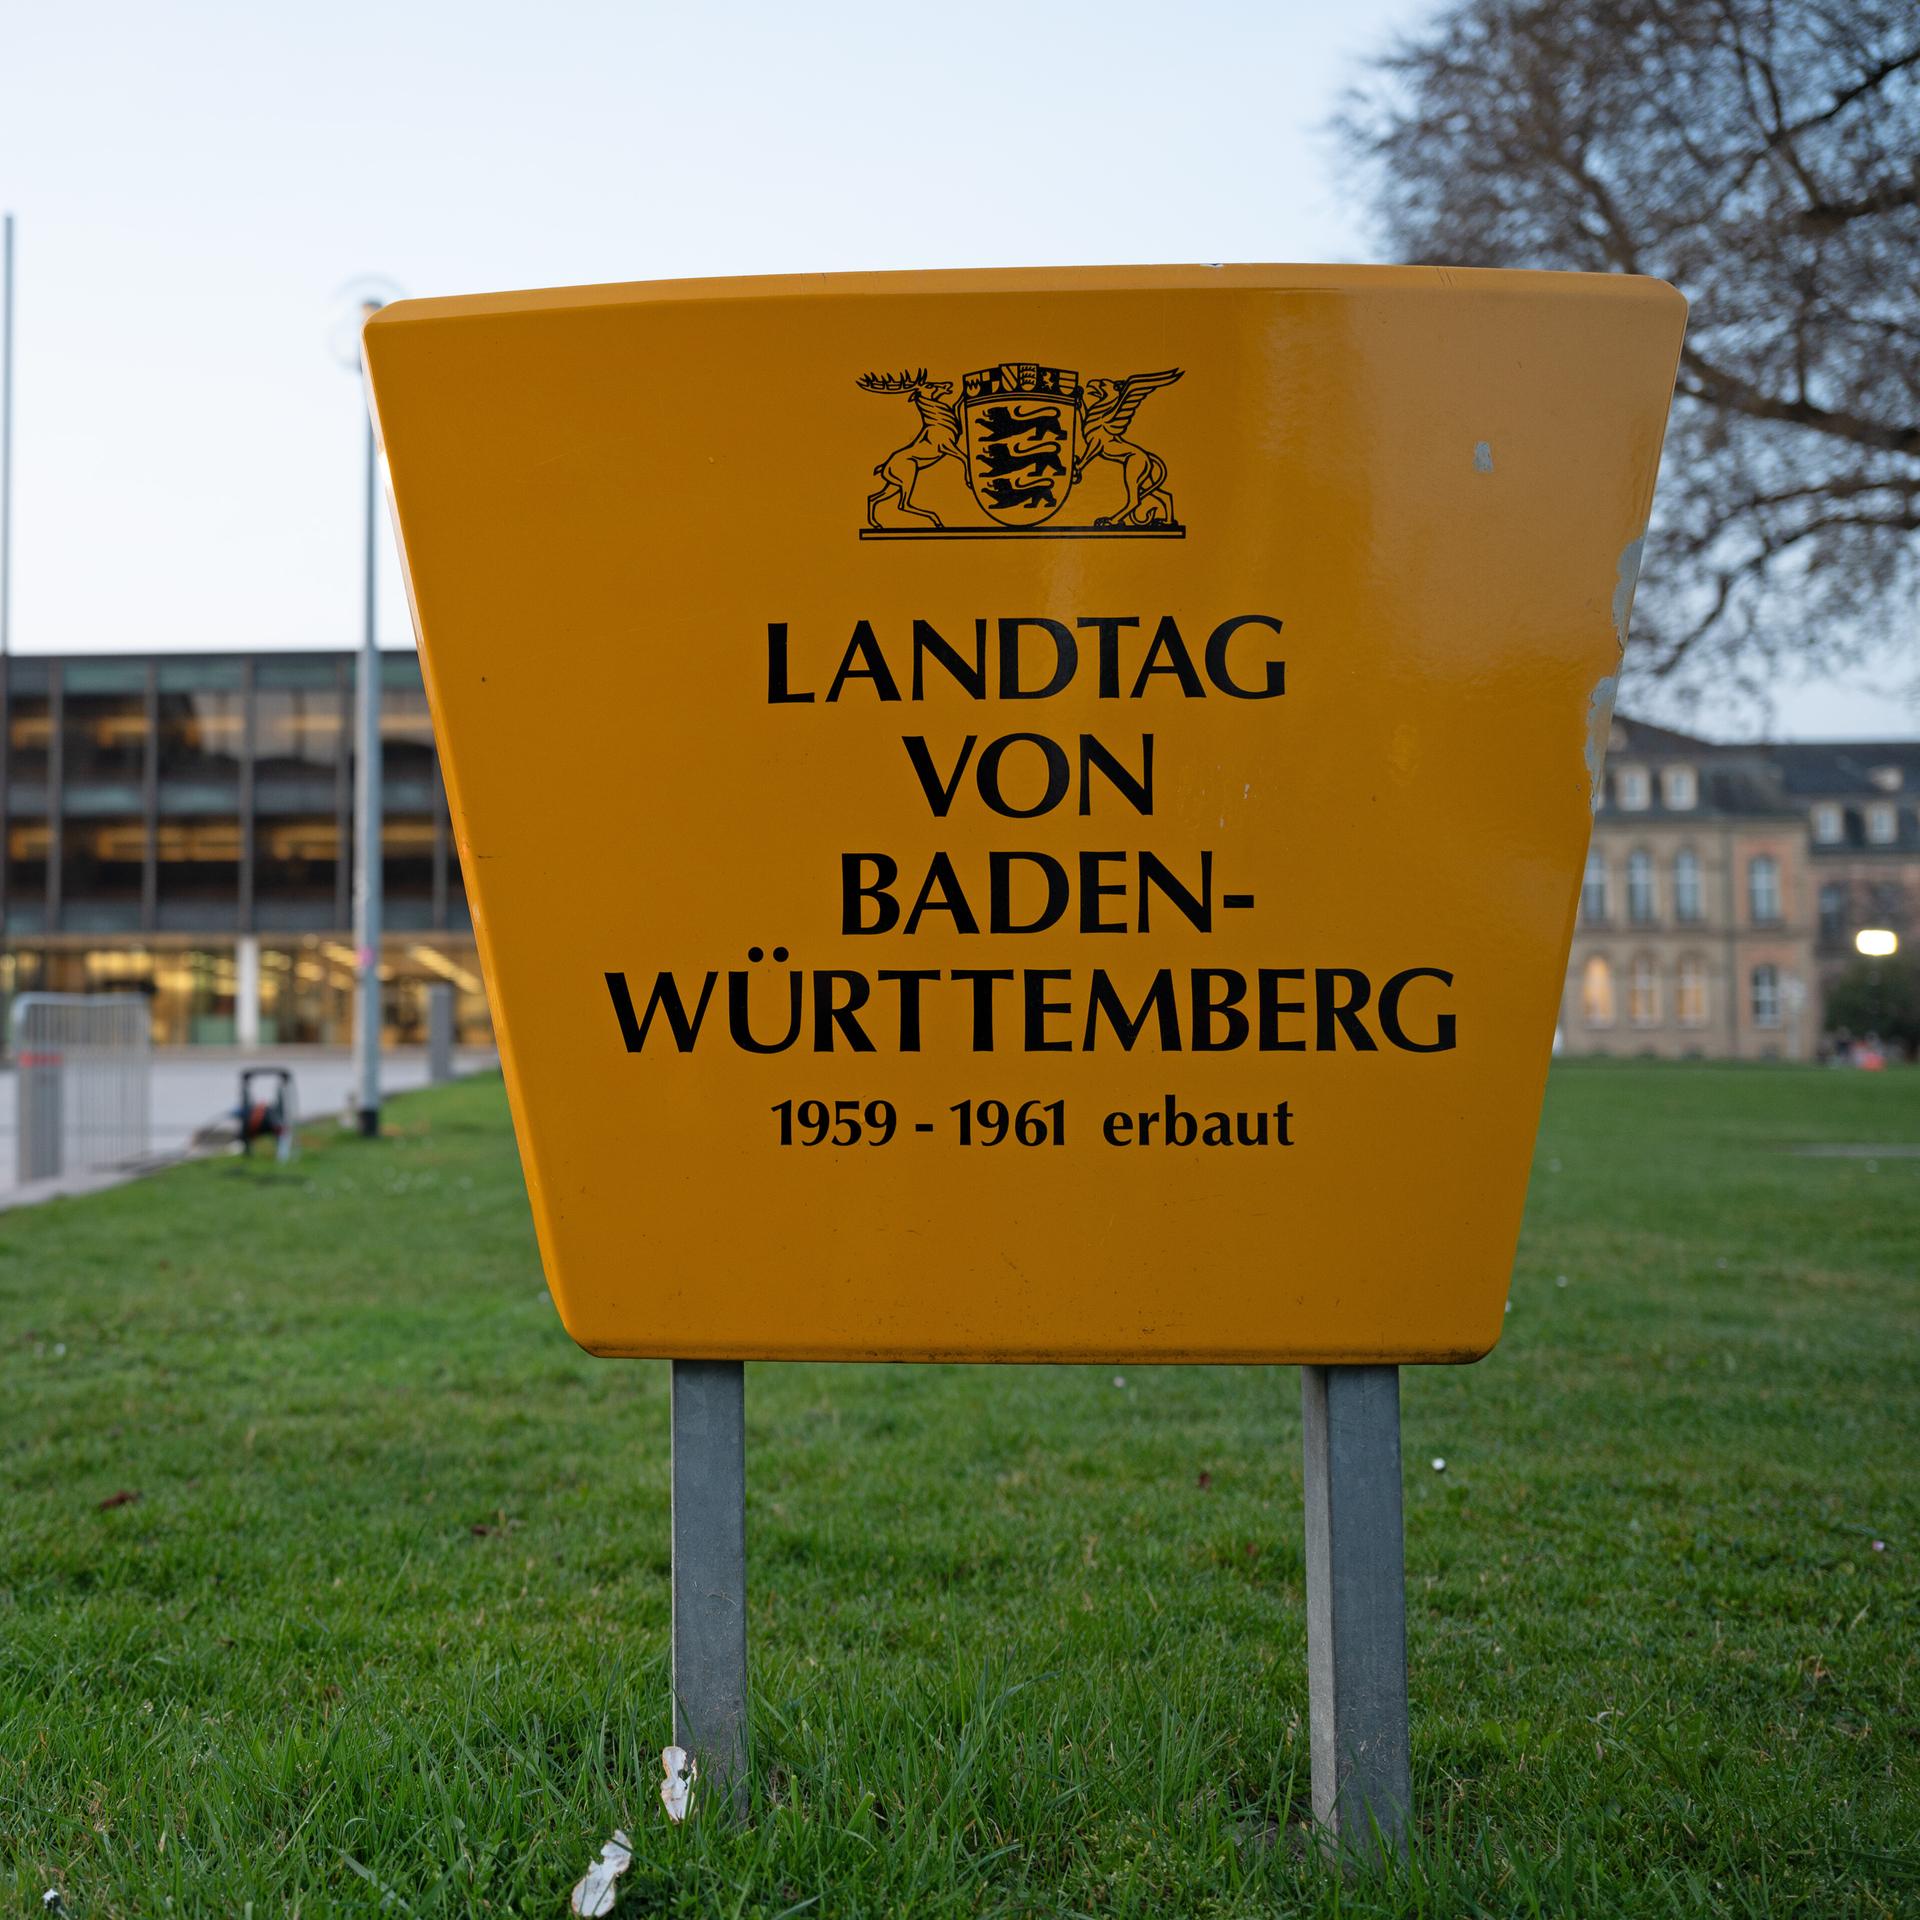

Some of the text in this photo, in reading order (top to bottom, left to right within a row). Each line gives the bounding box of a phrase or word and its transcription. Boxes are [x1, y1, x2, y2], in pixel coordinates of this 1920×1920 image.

[767, 614, 1286, 704] LANDTAG
[901, 732, 1155, 819] VON
[841, 850, 1255, 935] BADEN-
[603, 946, 1457, 1054] WÜRTTEMBERG
[770, 1093, 1295, 1147] 1959 - 1961 erbaut
